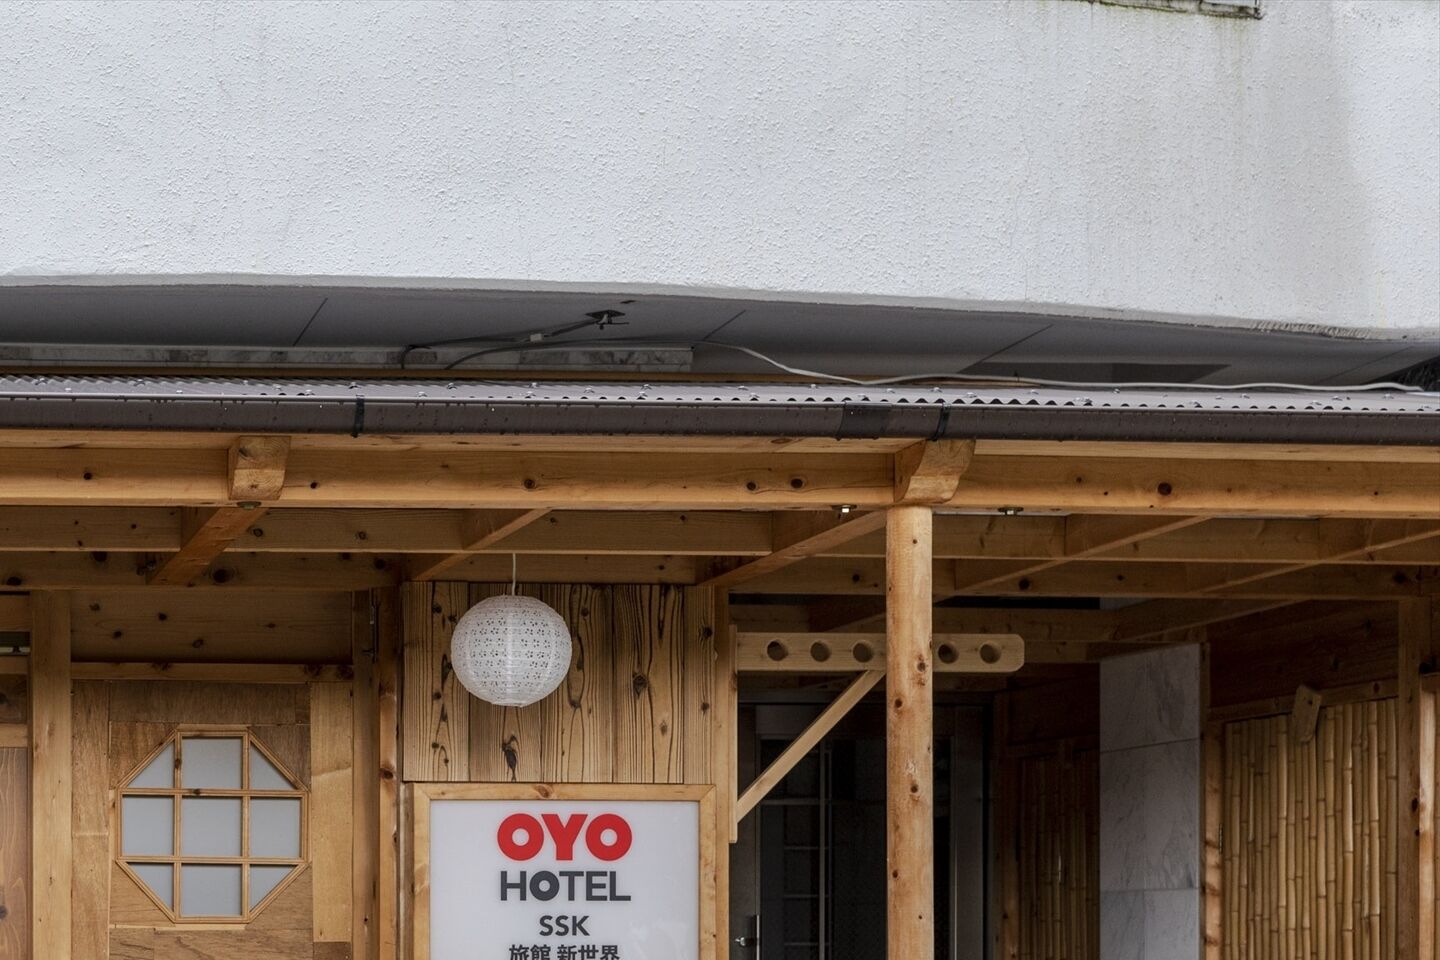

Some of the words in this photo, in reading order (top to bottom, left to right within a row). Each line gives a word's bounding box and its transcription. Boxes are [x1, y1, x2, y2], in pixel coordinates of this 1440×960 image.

[496, 812, 633, 862] OYO
[500, 870, 632, 902] HOTEL
[539, 915, 591, 937] SSK
